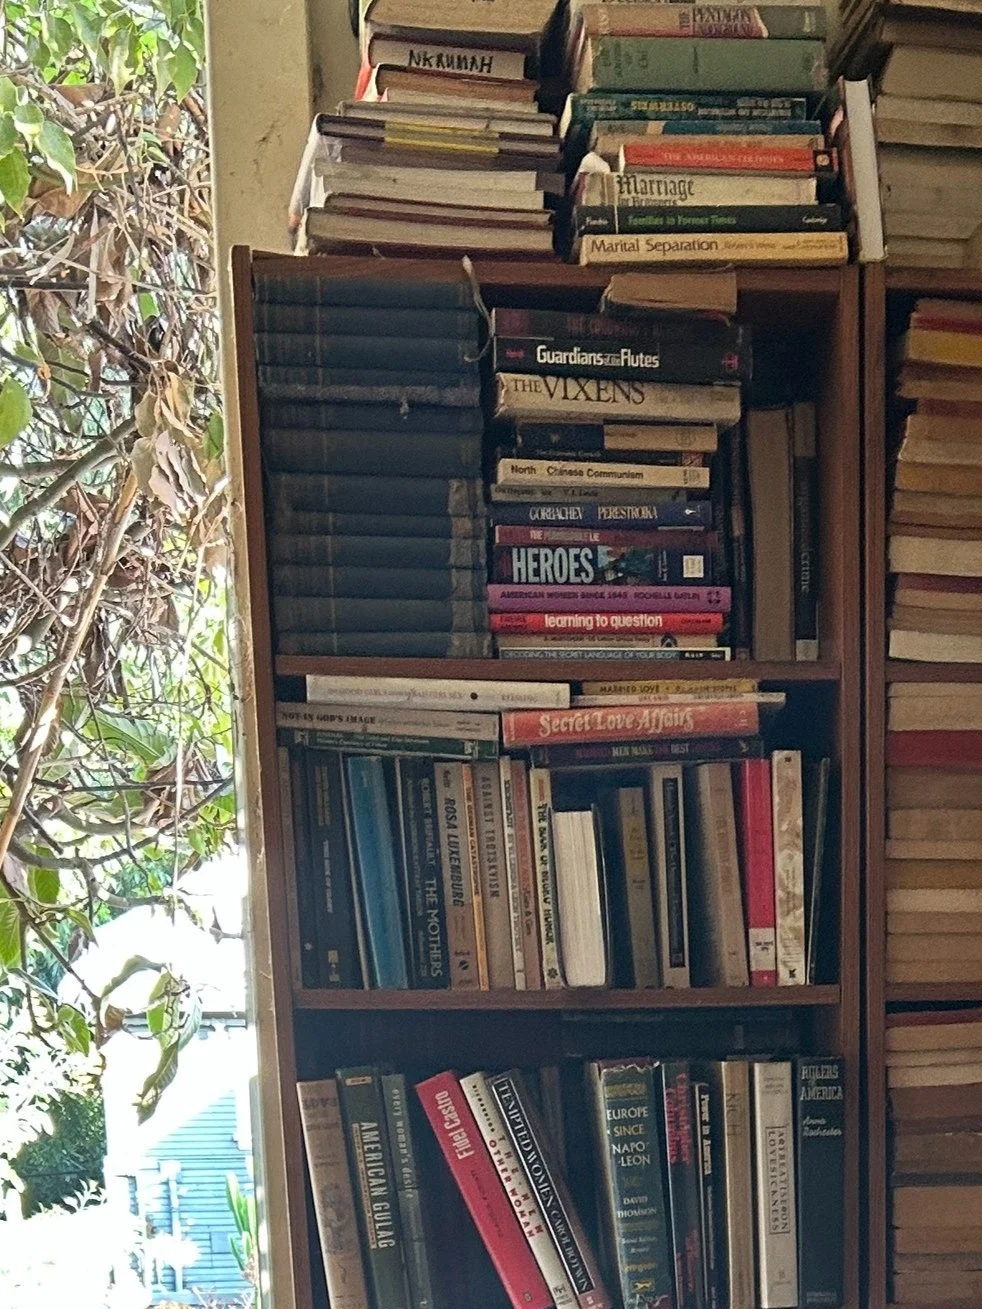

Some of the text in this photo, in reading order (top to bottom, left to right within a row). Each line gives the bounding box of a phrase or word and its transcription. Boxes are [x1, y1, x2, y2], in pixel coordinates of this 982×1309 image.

[408, 48, 493, 74] NKRUMAH
[617, 175, 695, 200] Marriage
[591, 239, 640, 253] Marital
[645, 238, 718, 256] Separation
[536, 345, 660, 368] Guardians Flutes
[511, 377, 646, 405] THE VIXENS
[510, 464, 644, 480] North Chinese Communism
[529, 506, 658, 521] GORBACHEV PERESTROIKA
[511, 547, 594, 584] HEROES
[545, 614, 663, 630] learning to question
[539, 707, 694, 737] Secret Love Affairs
[444, 798, 464, 908] ROSA LUXEMBURG
[800, 1087, 843, 1100] AMERICA
[435, 1090, 475, 1160] Fidel Castro
[607, 1106, 649, 1120] EUROPE
[614, 1124, 645, 1135] SINCE
[360, 1121, 396, 1249] AMERICAN GULAG
